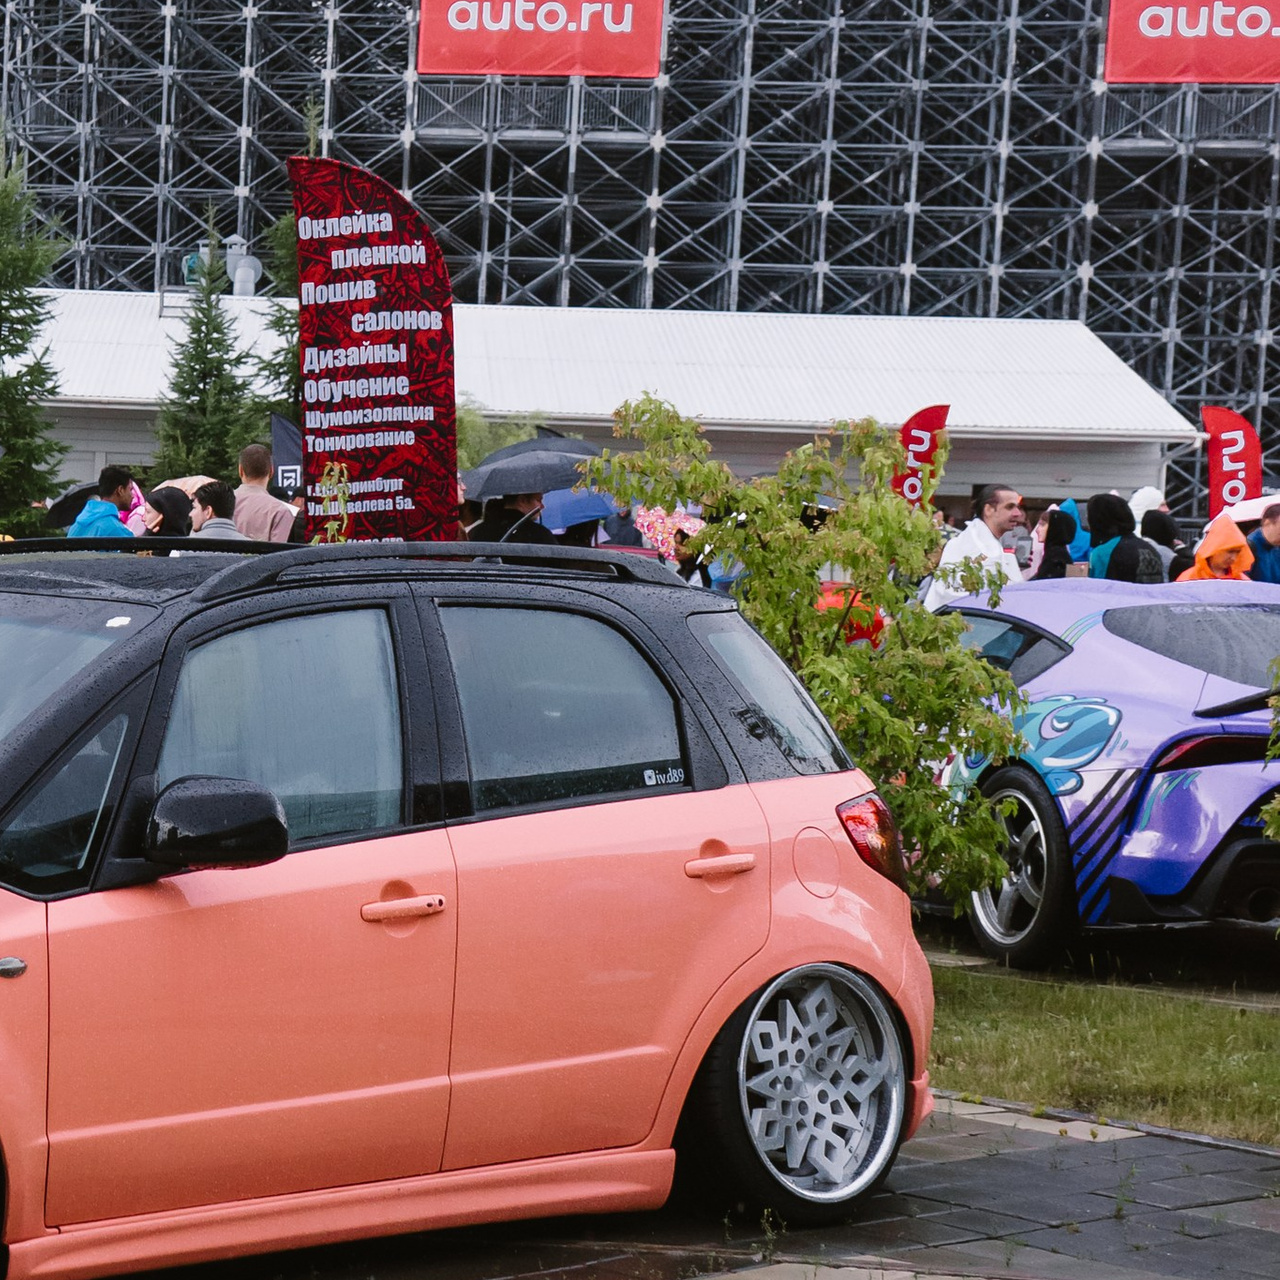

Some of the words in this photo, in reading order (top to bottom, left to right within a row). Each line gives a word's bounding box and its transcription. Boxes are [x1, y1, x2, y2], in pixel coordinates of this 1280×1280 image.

[298, 210, 393, 238] Оклейка
[331, 240, 426, 270] пленкой
[301, 279, 376, 306] Пошив
[351, 310, 443, 333] салонов
[303, 340, 407, 374] Дизайны
[304, 374, 410, 404] Обучение
[305, 405, 435, 429] Шумоизоляция
[305, 430, 415, 452] Тонирование
[903, 429, 931, 504] o.ru
[1221, 430, 1247, 505] o.ru
